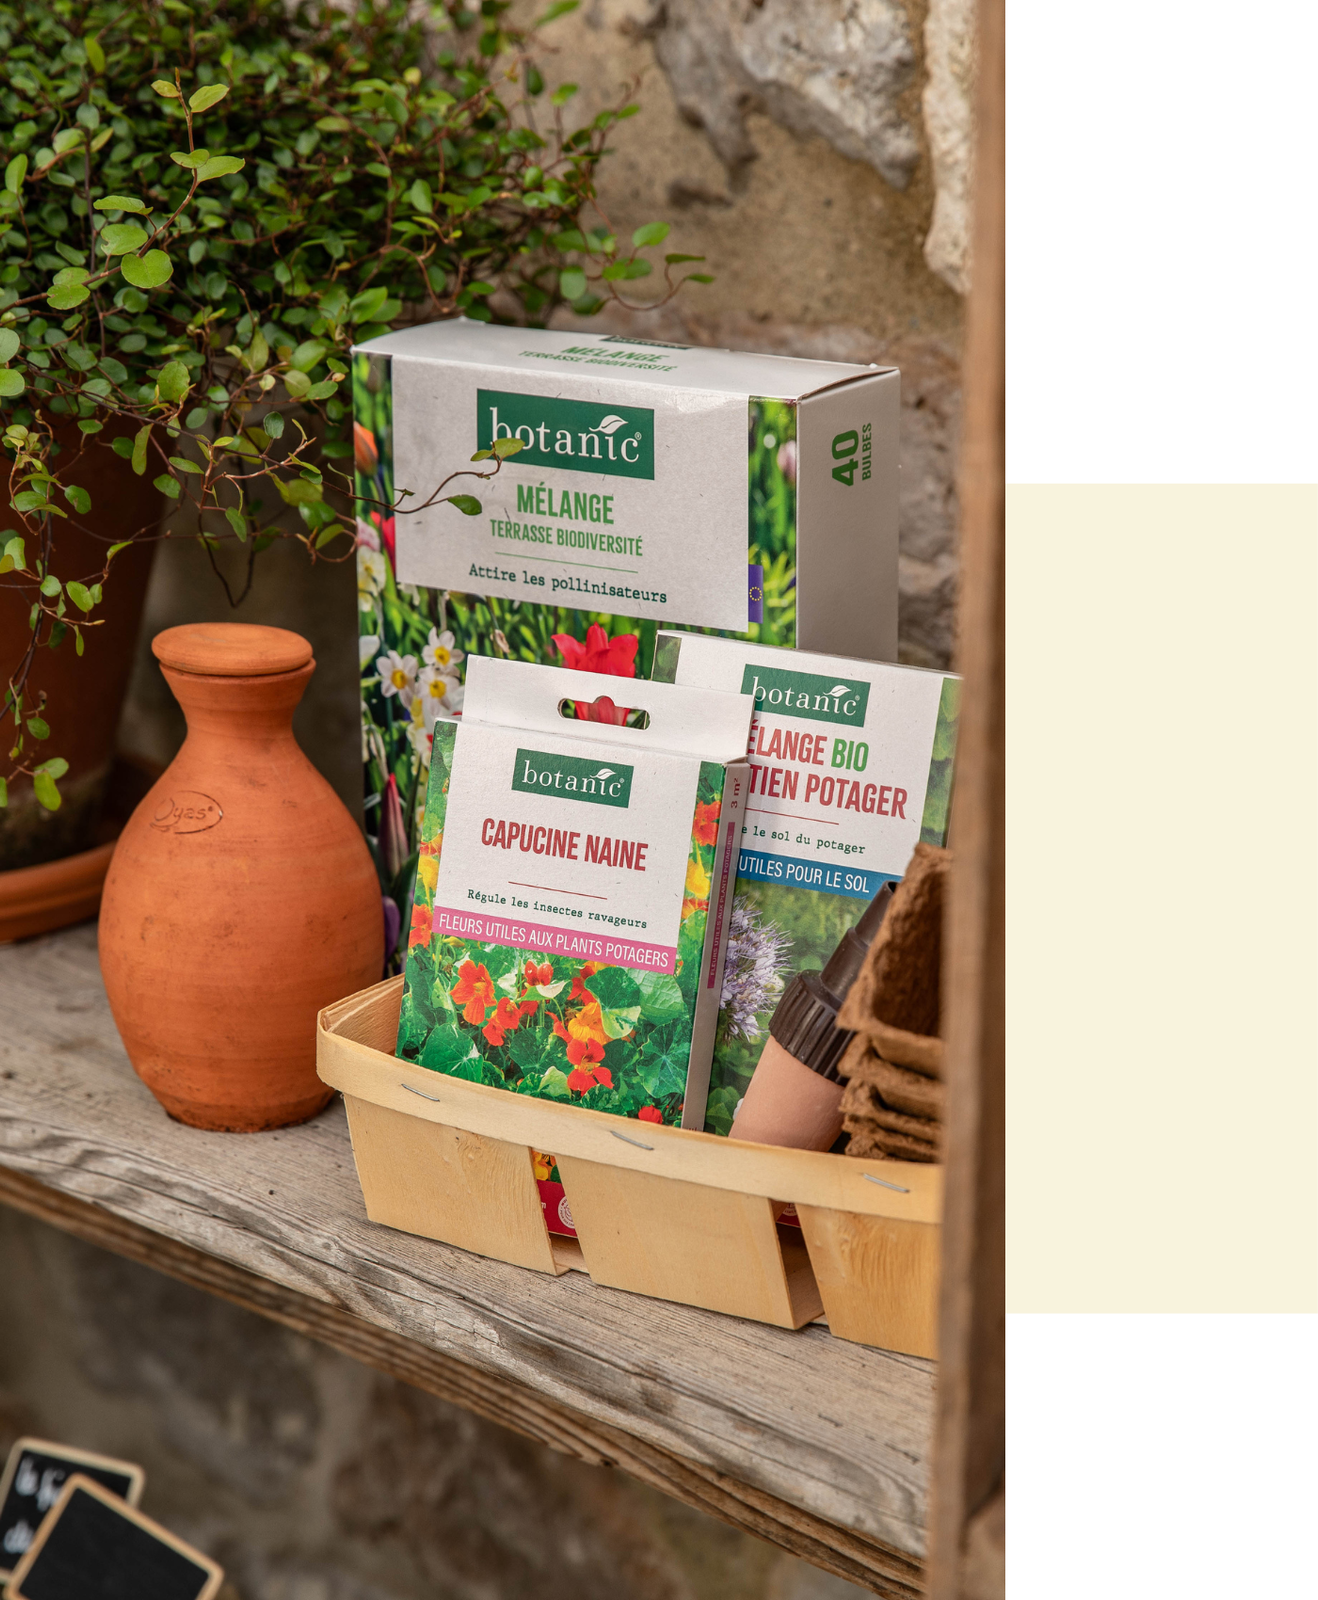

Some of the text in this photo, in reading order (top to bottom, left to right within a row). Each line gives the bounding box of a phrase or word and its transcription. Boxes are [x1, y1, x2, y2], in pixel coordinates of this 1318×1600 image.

[831, 429, 859, 487] 40
[861, 422, 872, 481] BULBES
[516, 481, 615, 525] MÉLANGE
[490, 518, 643, 557] TERRASSE BIODIVERSITÉ
[469, 562, 667, 604] Attire les pollinisateurs
[831, 738, 870, 772] BIO
[804, 773, 908, 820] POTAGER
[481, 817, 649, 872] CAPUCINE NAINE
[753, 825, 766, 837] le
[771, 831, 790, 842] sol
[795, 833, 811, 845] du
[816, 839, 866, 855] potager
[738, 855, 870, 893] UTILES POUR LE SOL
[467, 888, 647, 929] Régule les insectes ravageurs
[438, 913, 669, 968] FLEURS UTILES AUX PLANTS POTAGERS
